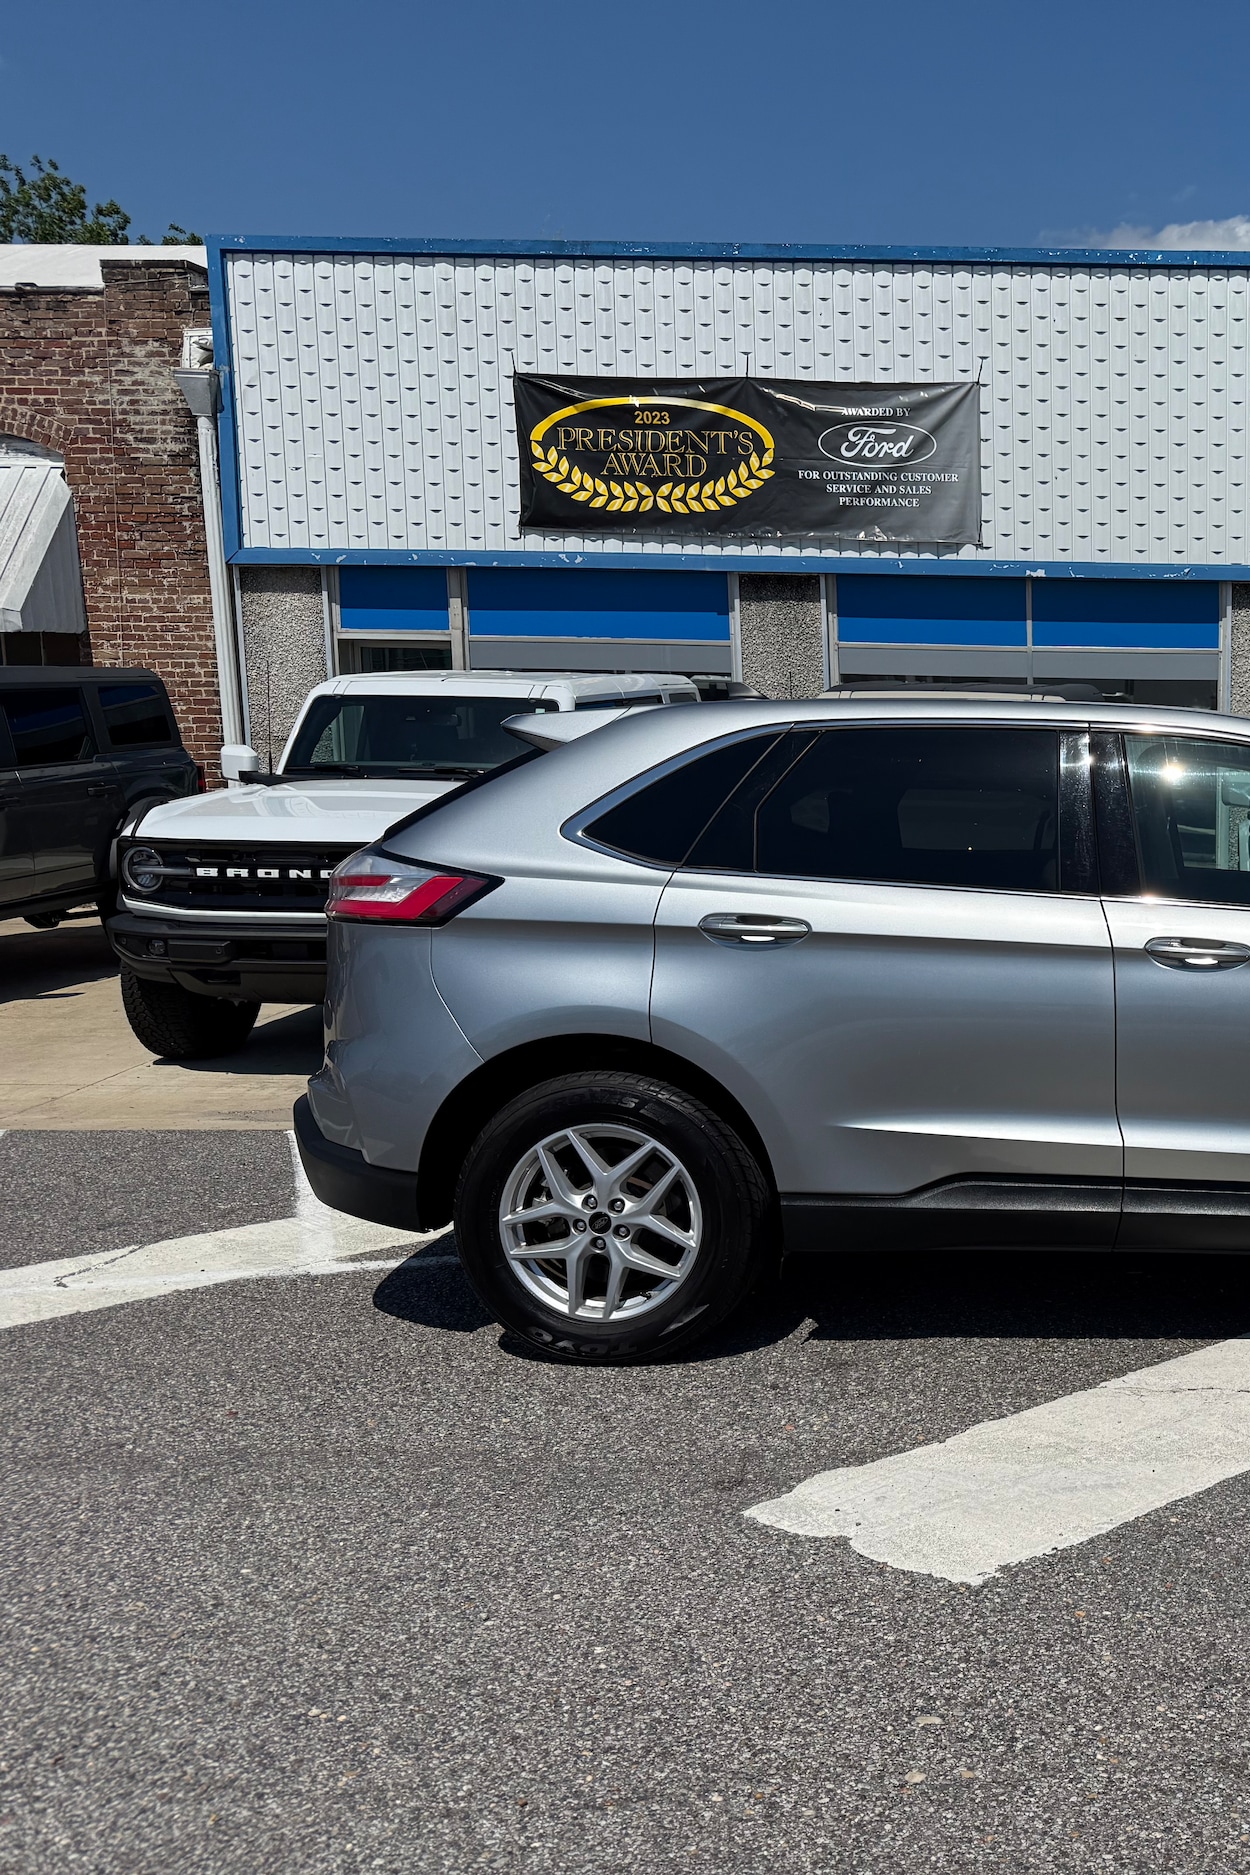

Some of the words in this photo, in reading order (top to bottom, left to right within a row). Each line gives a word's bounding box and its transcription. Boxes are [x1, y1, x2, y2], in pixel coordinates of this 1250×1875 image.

[634, 411, 670, 425] 2023
[841, 407, 893, 417] AWARDED
[896, 407, 911, 417] BY
[556, 427, 754, 455] PRESIDENT'S
[840, 426, 914, 458] Ford
[600, 452, 707, 478] AWARD
[798, 470, 820, 480] FOR
[823, 471, 898, 481] OUTSTANDING
[900, 472, 958, 482] CUSTOMER
[826, 484, 871, 494] SERVICE
[874, 485, 897, 494] AND
[899, 485, 932, 495] SALES
[839, 496, 920, 507] PERFORMANCE
